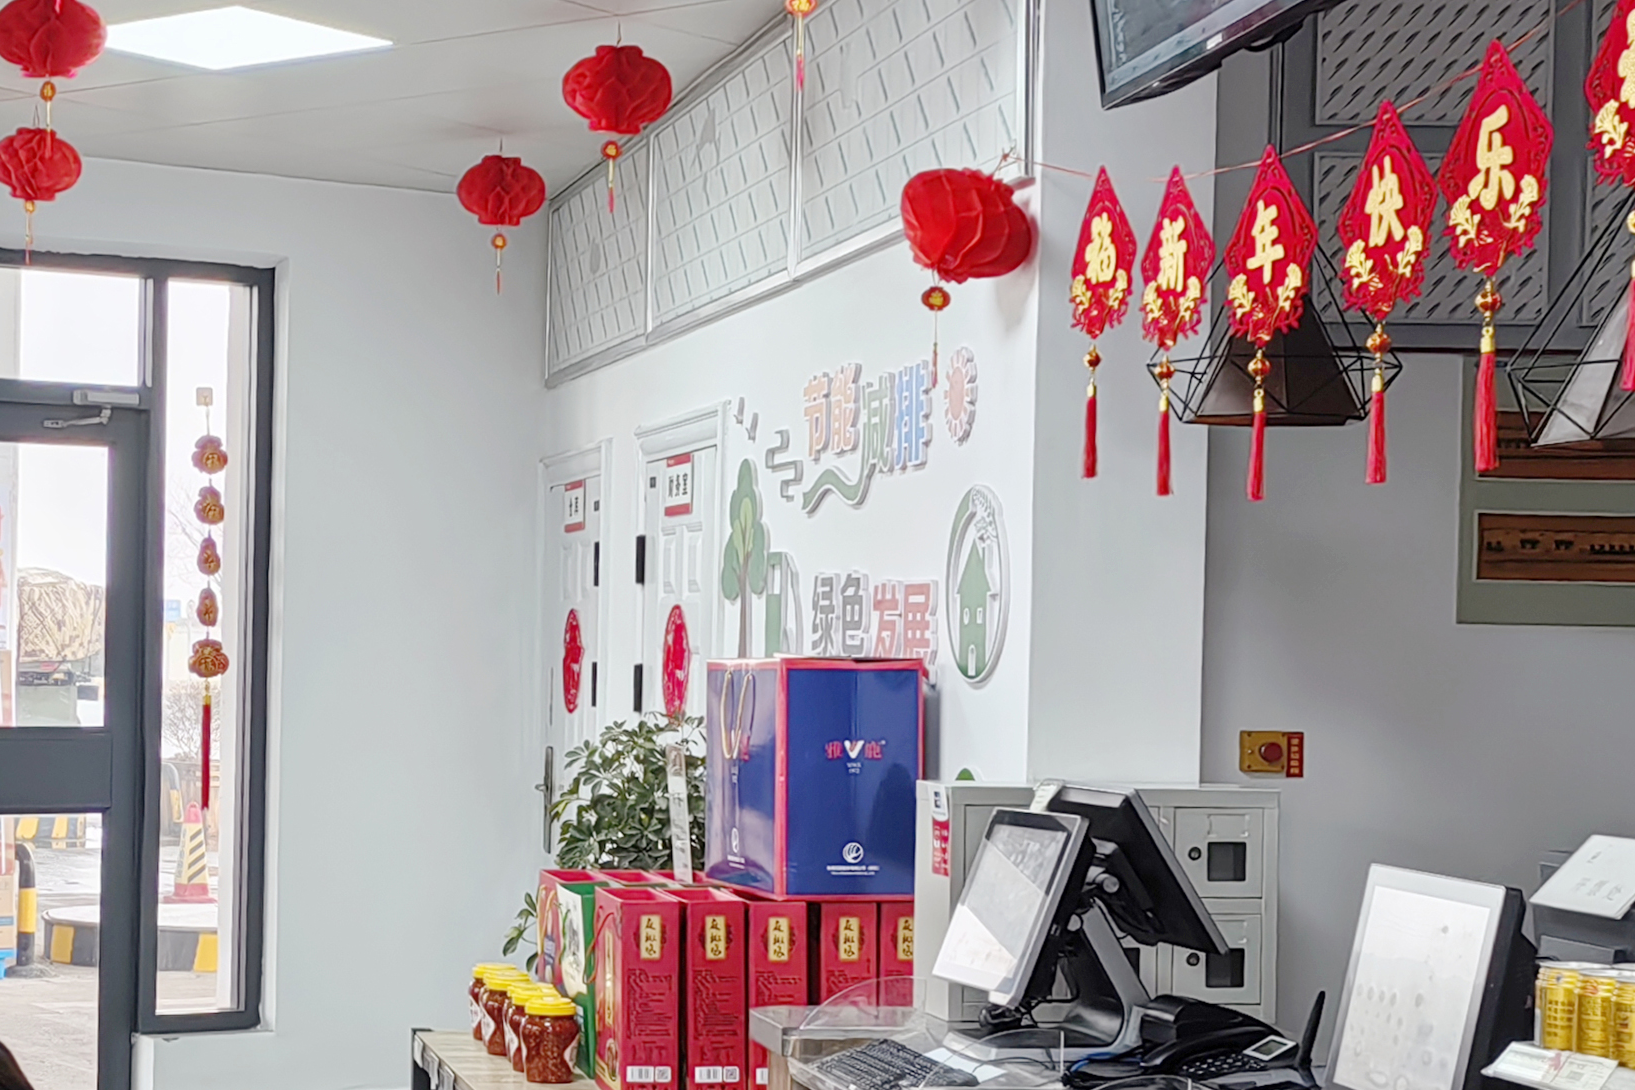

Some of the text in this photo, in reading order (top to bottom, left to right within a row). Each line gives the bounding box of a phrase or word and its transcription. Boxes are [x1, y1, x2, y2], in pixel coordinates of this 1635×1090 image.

[1157, 215, 1187, 292] 新
[1246, 199, 1285, 285] 年
[1364, 156, 1404, 247] 快
[1468, 104, 1516, 209] 乐
[803, 360, 933, 474] 节能减排
[812, 572, 937, 659] 绿色发展
